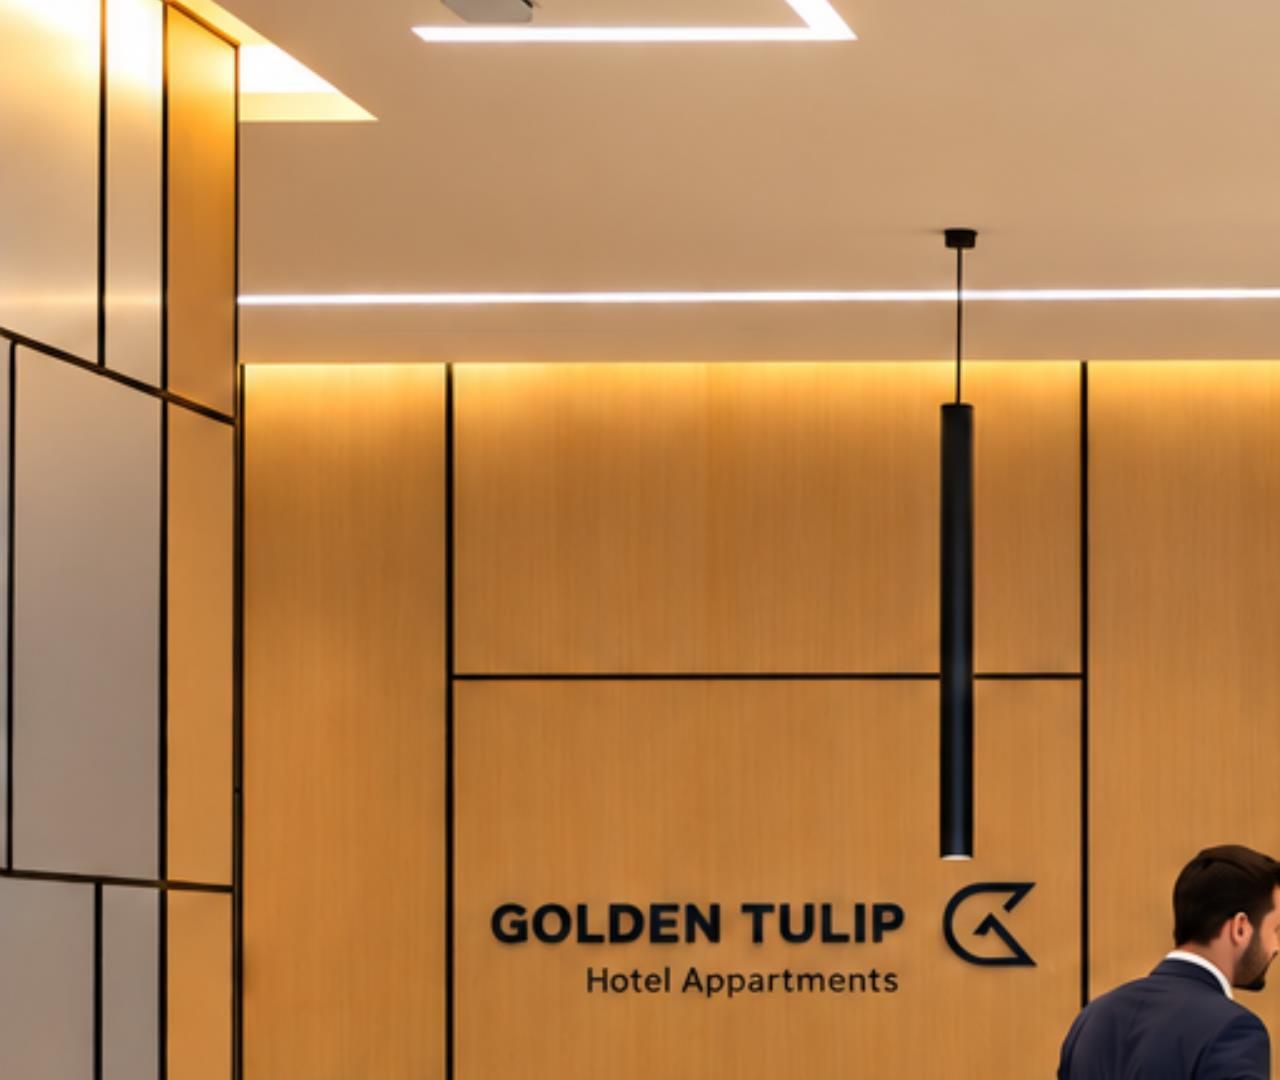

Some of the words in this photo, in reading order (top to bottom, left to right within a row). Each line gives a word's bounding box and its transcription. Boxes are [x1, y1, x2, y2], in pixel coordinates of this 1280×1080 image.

[490, 902, 721, 945] GOLDEN
[740, 902, 905, 945] TULIP
[586, 966, 671, 993] Hotel
[681, 966, 899, 998] Appartments
